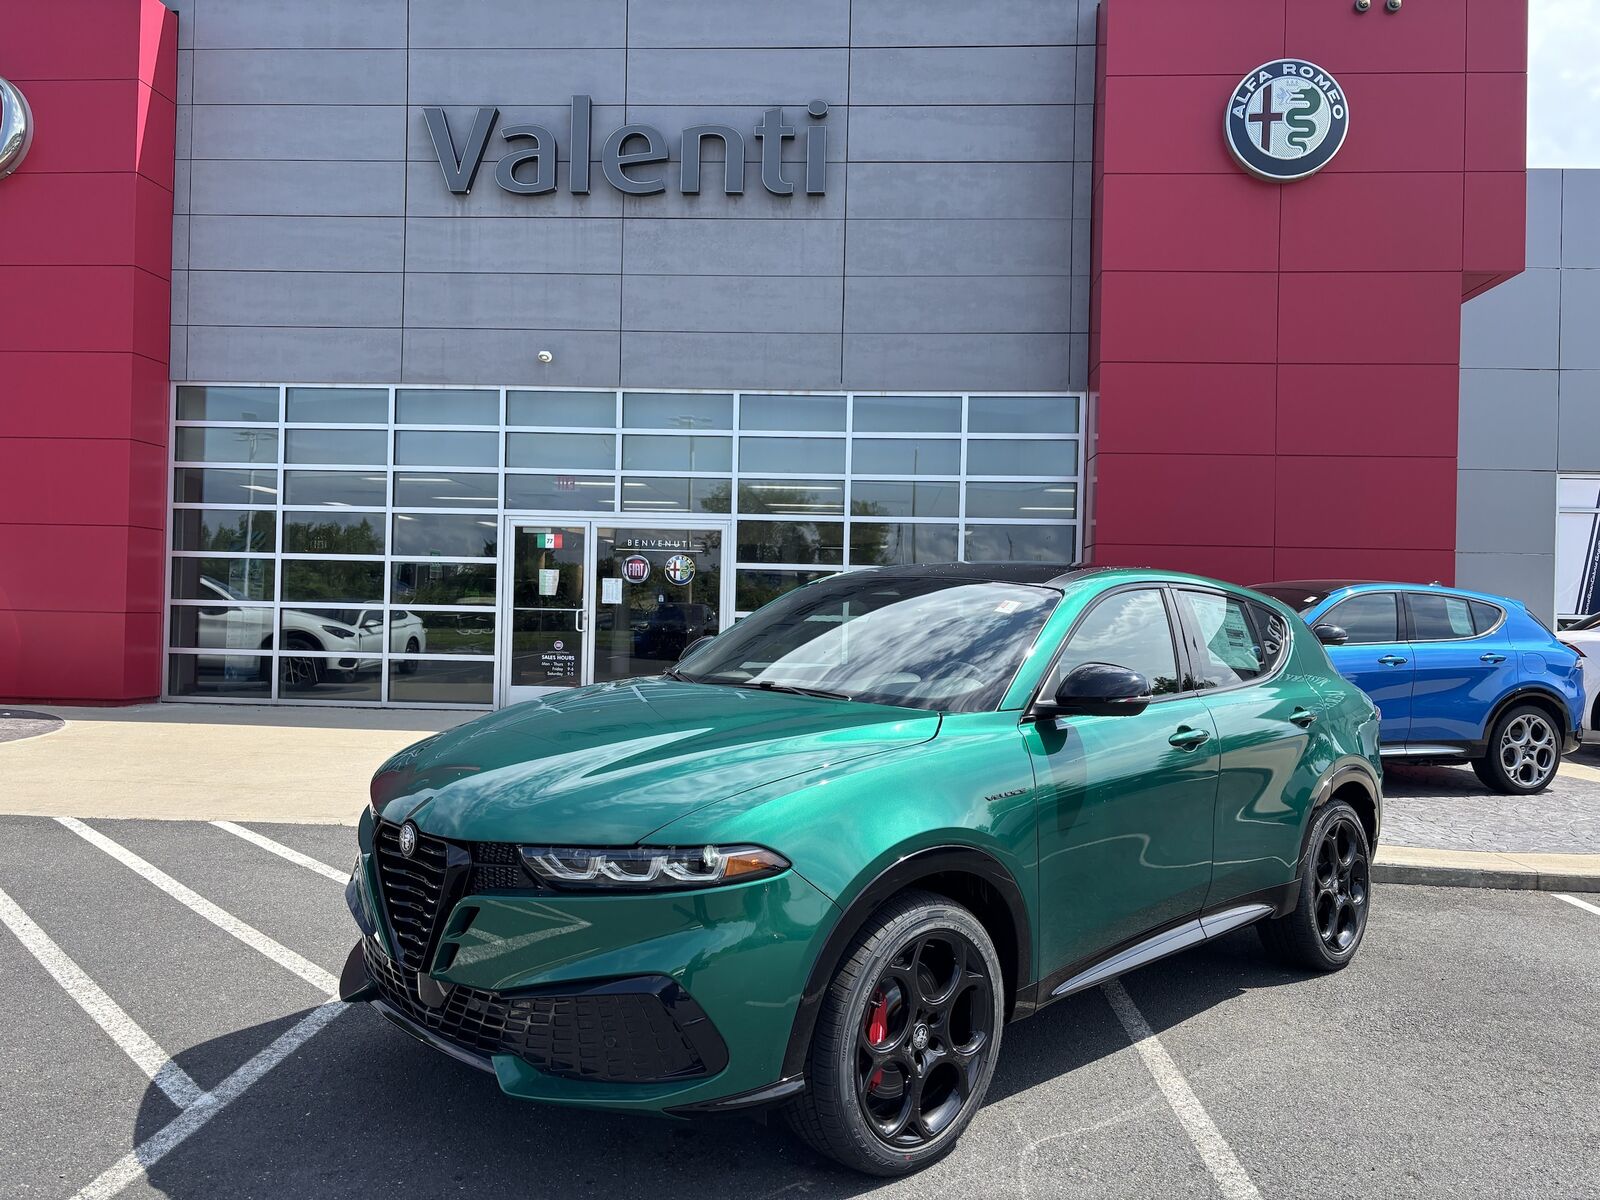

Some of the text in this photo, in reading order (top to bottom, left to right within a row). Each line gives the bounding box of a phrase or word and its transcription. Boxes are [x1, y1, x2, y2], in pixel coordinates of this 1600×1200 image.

[1232, 63, 1344, 120] ALFA ROMEO
[422, 94, 829, 196] Valenti
[627, 539, 692, 548] BENVENUTI
[628, 563, 645, 577] FIAT
